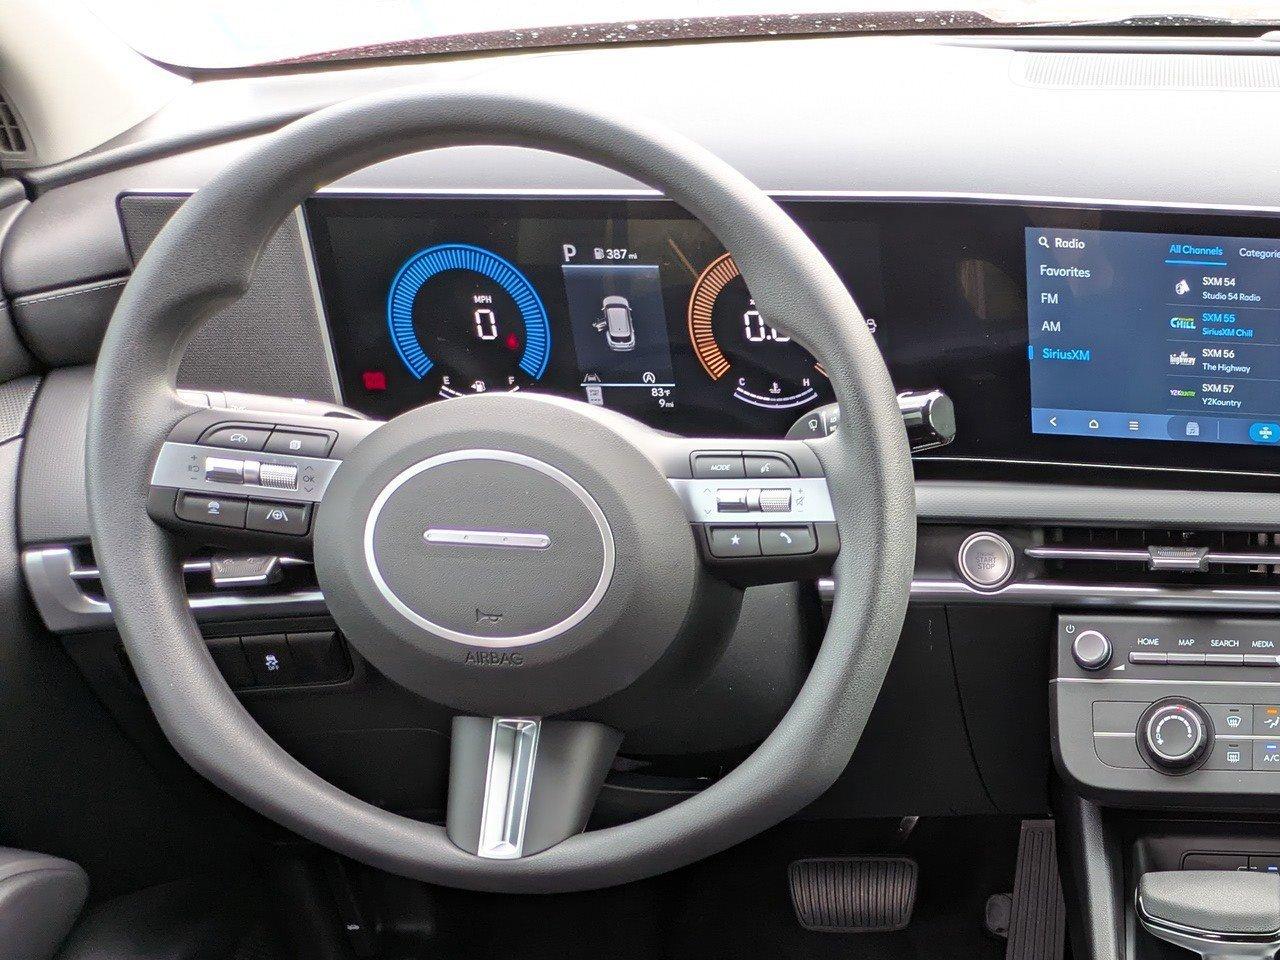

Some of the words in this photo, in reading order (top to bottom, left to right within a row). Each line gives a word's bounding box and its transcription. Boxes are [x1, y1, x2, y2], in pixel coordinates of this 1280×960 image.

[1054, 237, 1086, 250] Radio
[562, 244, 577, 261] P
[606, 249, 627, 260] 387
[1169, 244, 1182, 255] All
[1183, 245, 1224, 256] Channels
[1039, 264, 1091, 279] Favorites
[1202, 276, 1222, 287] SXM
[1223, 277, 1236, 287] 54
[473, 295, 493, 304] MPH
[1040, 293, 1059, 304] FM
[1202, 291, 1227, 301] Studio
[1228, 292, 1238, 301] 54
[1239, 293, 1261, 302] Radio
[1202, 312, 1222, 323] SXM
[1223, 313, 1236, 323] 55
[474, 308, 498, 341] 0
[1041, 320, 1061, 332] AM
[1202, 327, 1235, 337] SiriusXM
[1235, 328, 1253, 338] Chill
[1041, 348, 1091, 362] SiriusXM
[1202, 348, 1222, 358] SXM
[1223, 349, 1235, 358] 56
[1202, 362, 1216, 371] The
[1217, 363, 1251, 373] Highway
[738, 377, 746, 386] C
[803, 377, 810, 387] H
[1202, 383, 1222, 393] SXM
[1223, 384, 1235, 394] 57
[1202, 397, 1241, 409] Y2Kountry
[711, 463, 731, 471] MODE
[302, 474, 316, 483] OK
[1136, 637, 1160, 646] HOME
[1178, 638, 1195, 647] MAP
[1210, 639, 1240, 648] SEARCH
[1251, 640, 1275, 649] MEDIA
[464, 651, 524, 668] AIRBAG
[1263, 754, 1280, 763] A/C
